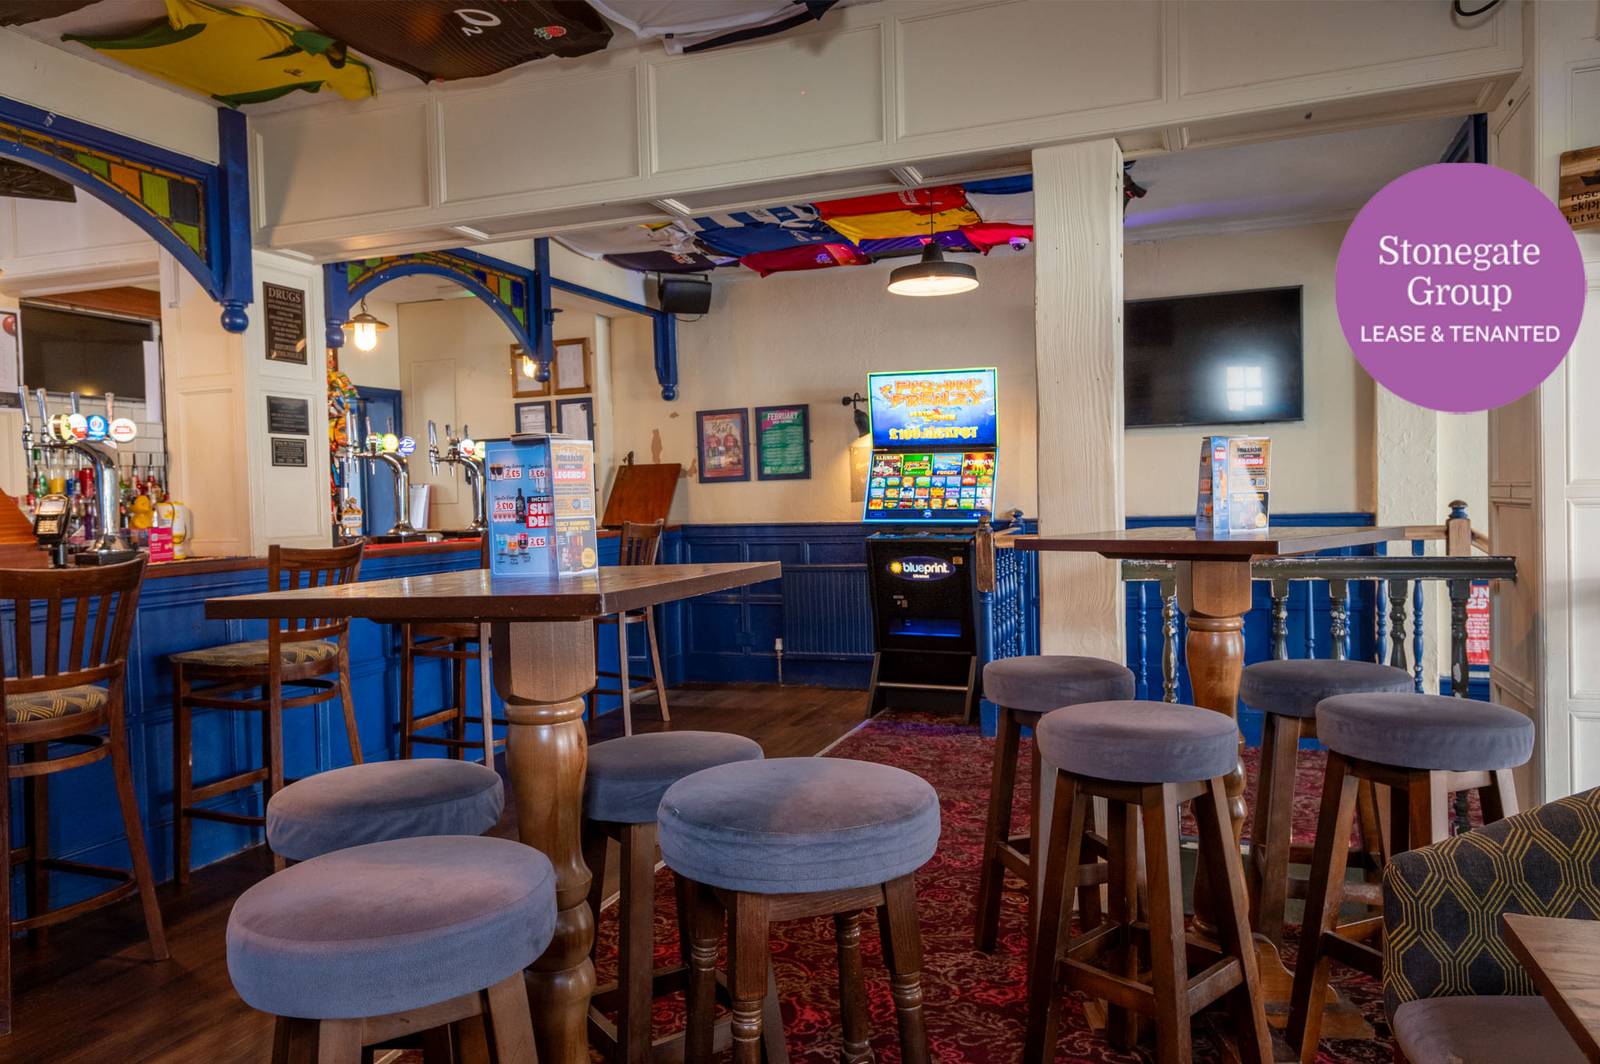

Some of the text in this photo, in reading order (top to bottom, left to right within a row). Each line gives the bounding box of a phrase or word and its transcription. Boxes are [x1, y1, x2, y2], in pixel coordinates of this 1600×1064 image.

[268, 287, 301, 303] DRUGS
[891, 390, 985, 408] FRENZY
[767, 412, 798, 421] FEBRUARY
